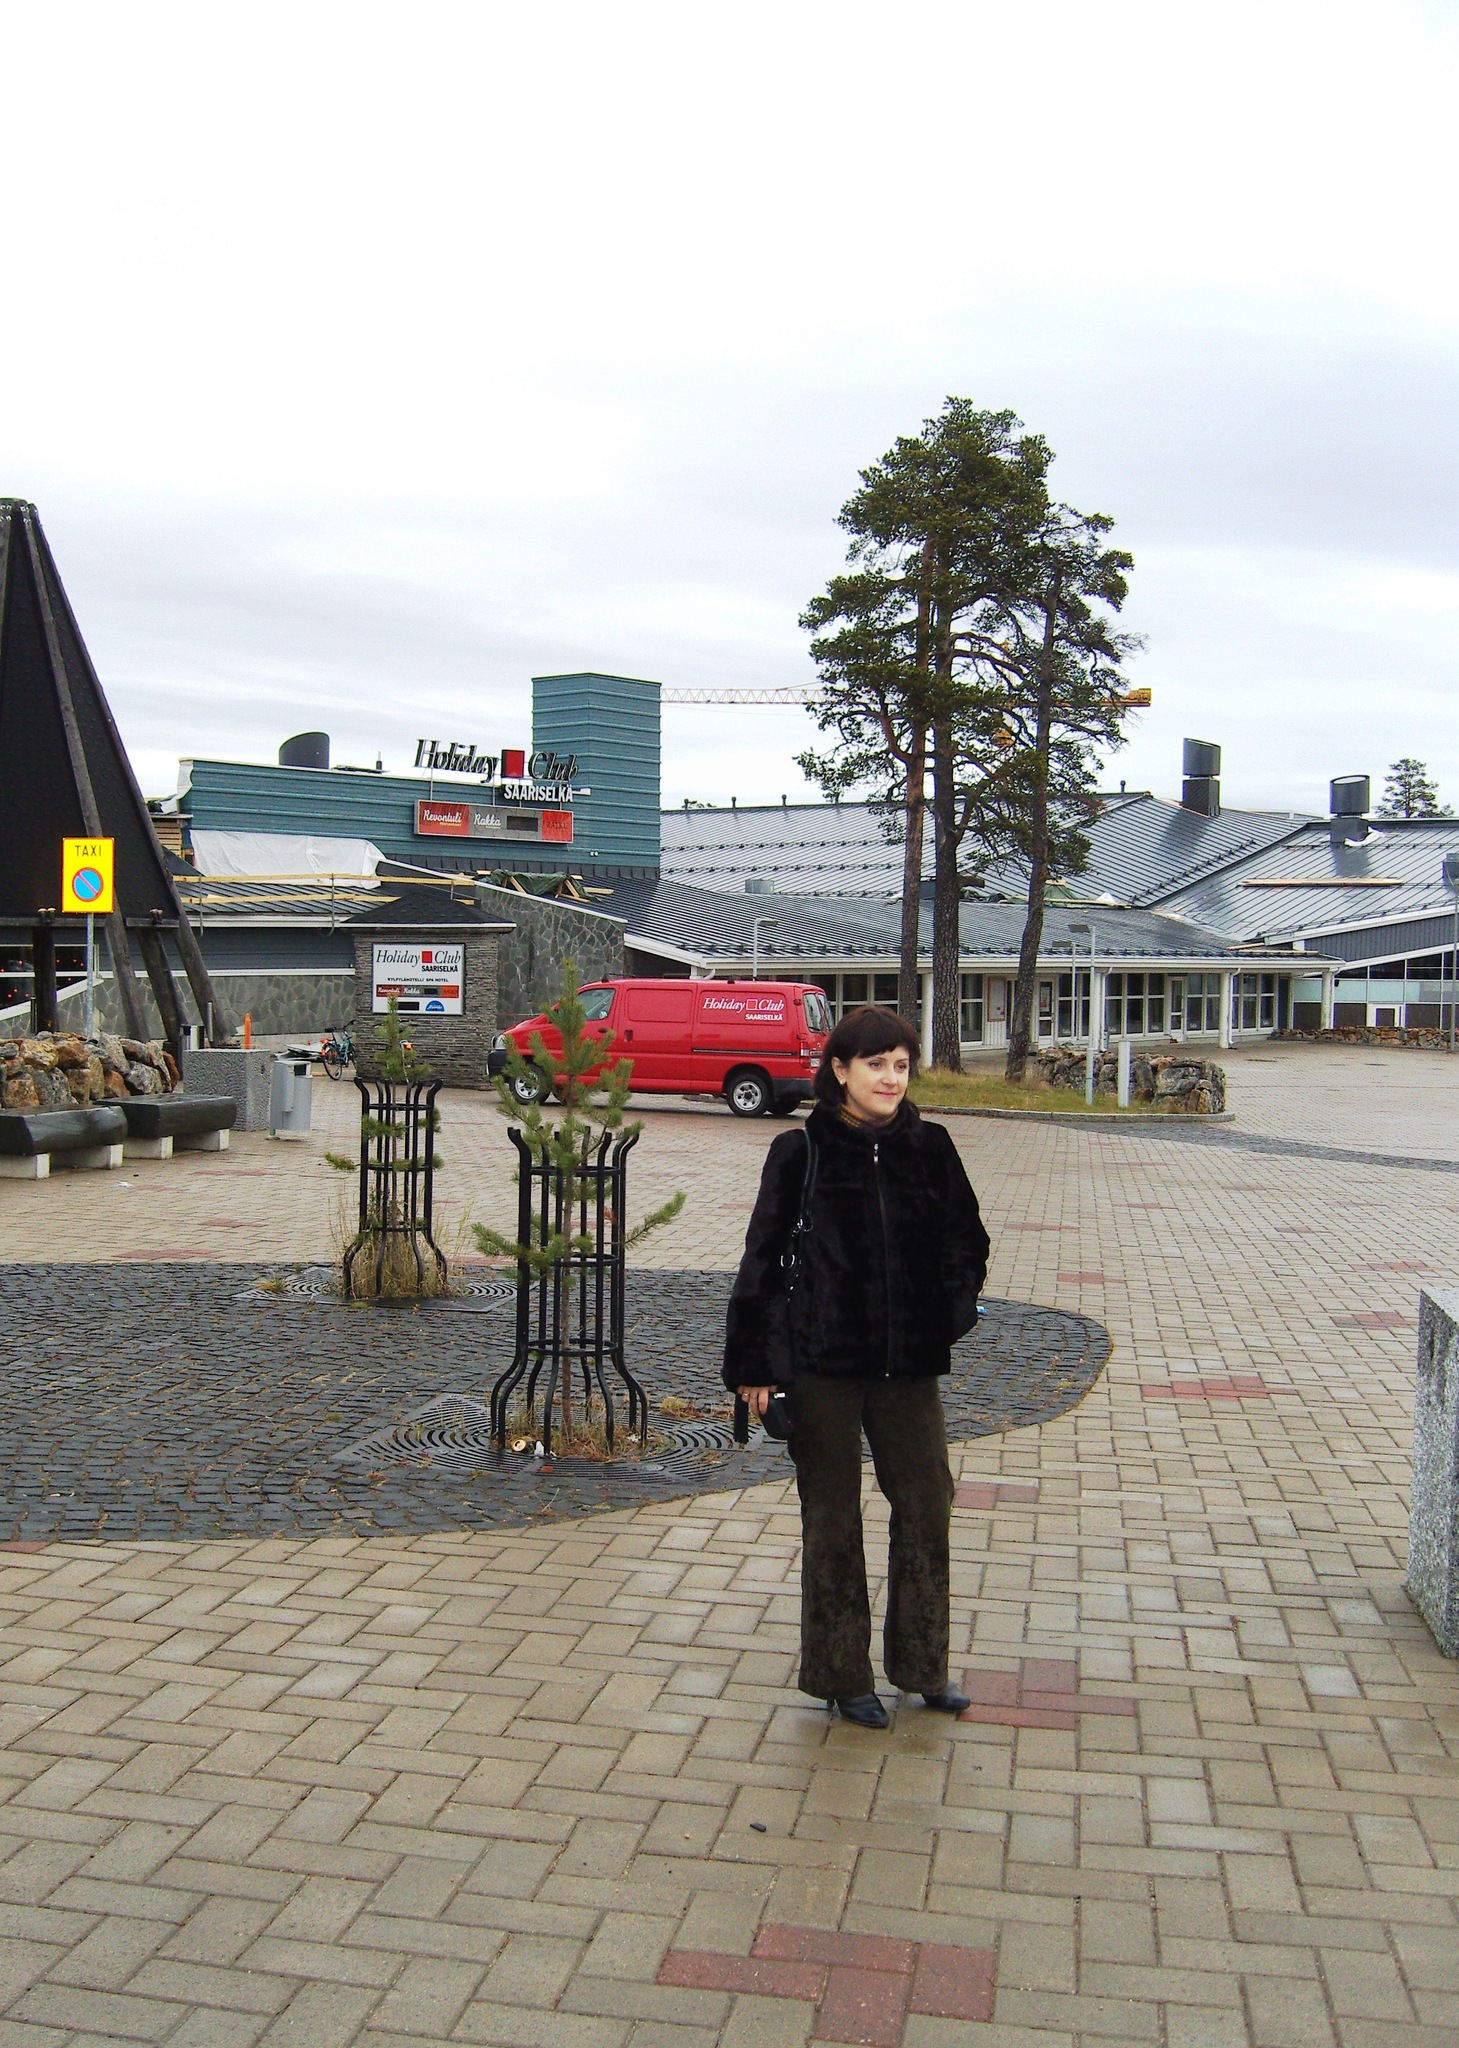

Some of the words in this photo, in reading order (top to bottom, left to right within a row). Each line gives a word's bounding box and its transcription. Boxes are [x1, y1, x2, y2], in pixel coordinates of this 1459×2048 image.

[413, 739, 499, 784] Holiday
[527, 751, 579, 781] Club
[503, 784, 573, 803] SAARISELKÄ
[423, 809, 462, 823] Revontuli
[474, 813, 502, 826] Rakka
[75, 845, 102, 857] TAXI
[376, 949, 420, 967] Holiday
[434, 950, 461, 964] Club
[703, 998, 746, 1014] Holiday
[758, 1000, 784, 1011] Club
[745, 1013, 783, 1021] SAARISELKÄ
